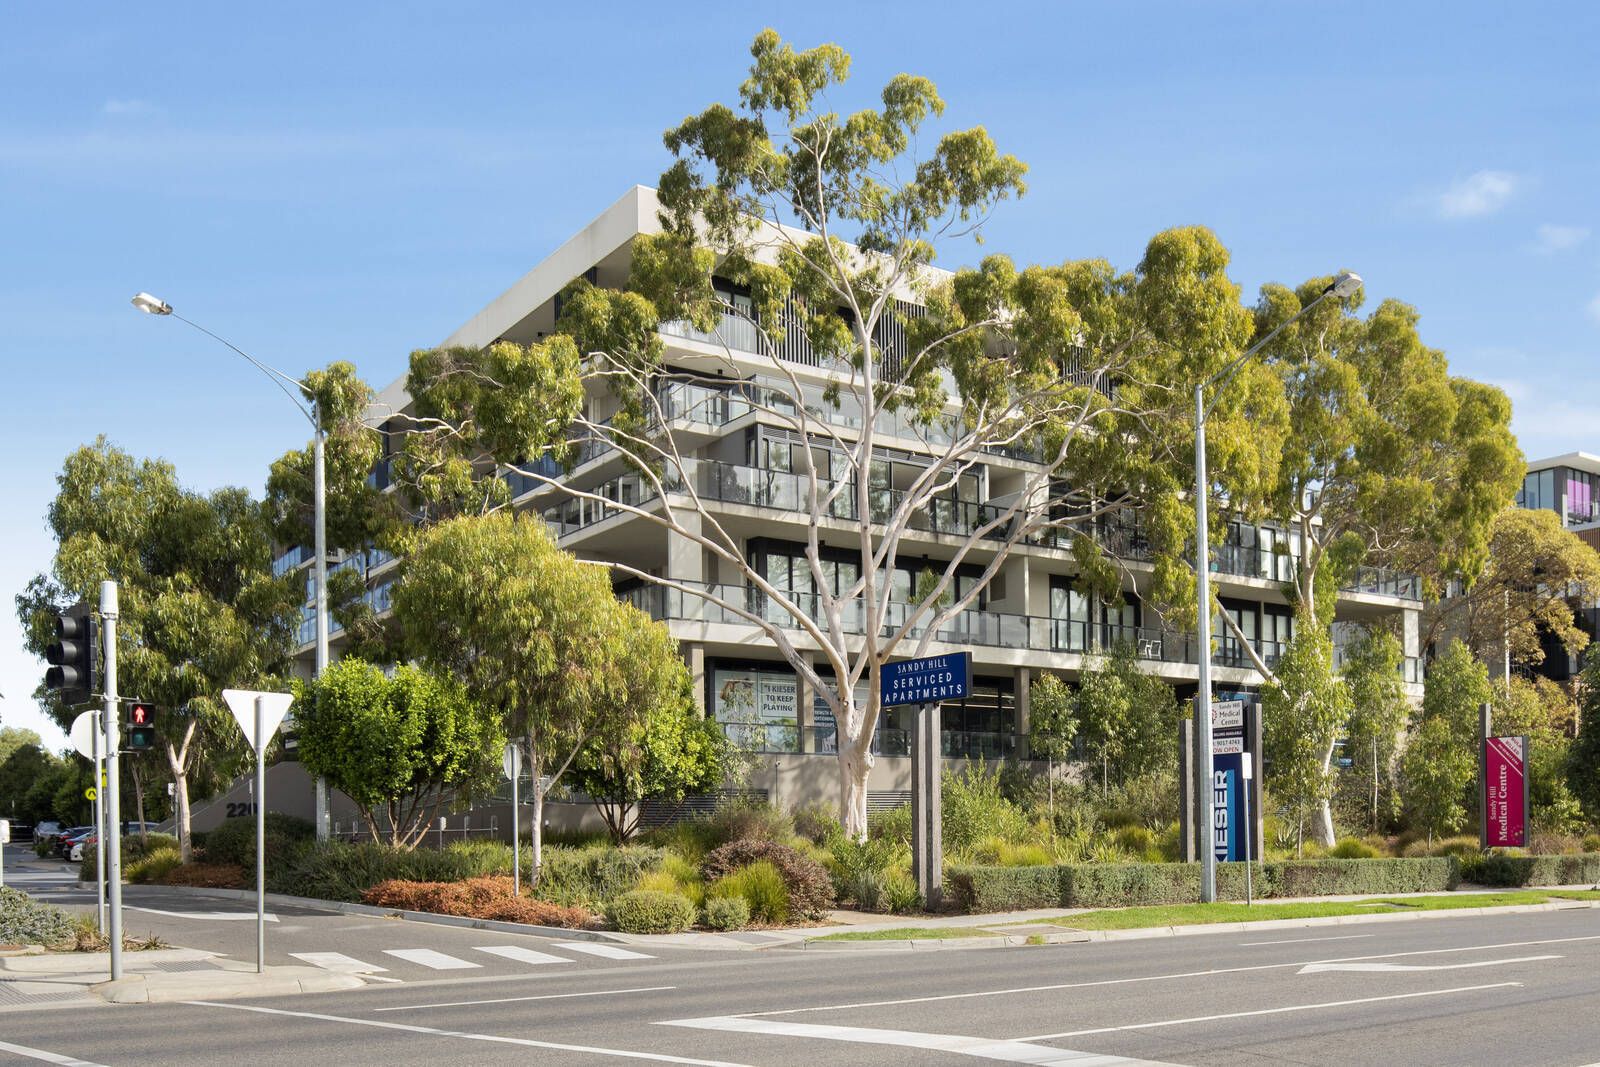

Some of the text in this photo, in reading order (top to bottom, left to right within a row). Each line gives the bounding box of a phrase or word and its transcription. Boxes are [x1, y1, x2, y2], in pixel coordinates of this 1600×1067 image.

[897, 657, 948, 674] SANDY HILL
[772, 685, 795, 693] KIESER
[893, 672, 952, 689] SERVICED
[884, 684, 962, 703] APARTMENTS
[1219, 709, 1241, 718] Medical
[1221, 718, 1239, 726] Centre
[1498, 764, 1507, 841] Medical Centre
